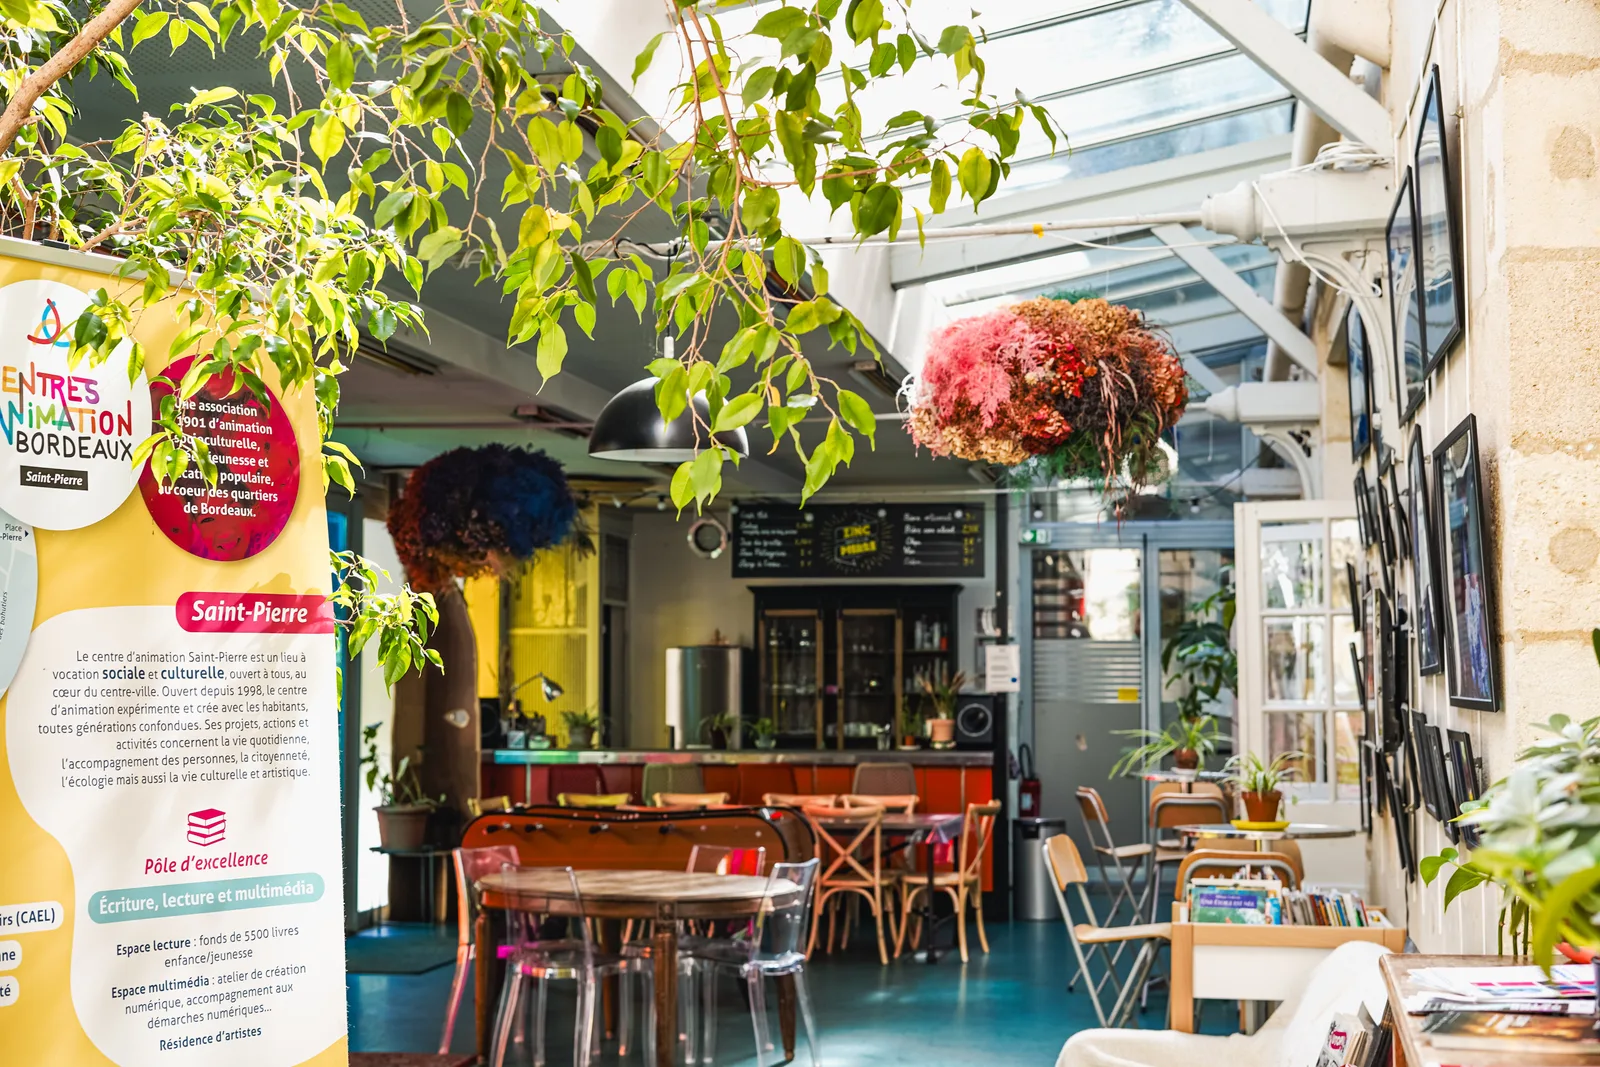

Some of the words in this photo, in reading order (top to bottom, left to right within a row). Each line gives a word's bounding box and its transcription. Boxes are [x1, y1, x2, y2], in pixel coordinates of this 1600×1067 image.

[198, 402, 257, 416] association
[176, 417, 206, 428] 1901
[209, 418, 272, 434] d'animation
[16, 430, 132, 461] BORDEAUX
[258, 458, 269, 467] et
[26, 471, 82, 486] Saint-Pierre
[220, 472, 274, 486] populaire,
[174, 487, 206, 496] coeur
[209, 487, 228, 498] des
[231, 489, 278, 502] quartiers
[184, 502, 198, 513] de
[201, 503, 256, 517] Bordeaux.
[5, 524, 22, 532] Place
[192, 600, 308, 623] Saint-Pierre
[77, 651, 89, 662] Le
[92, 652, 124, 662] centre
[126, 652, 185, 662] d'animation
[189, 652, 247, 663] Saint-Pierre
[250, 653, 265, 662] est
[280, 652, 298, 662] lieu
[301, 652, 306, 663] à
[52, 669, 99, 680] vocation
[102, 666, 145, 680] sociale
[148, 670, 158, 679] et
[161, 666, 227, 680] culturelle,
[229, 670, 261, 679] ouvert
[264, 668, 268, 679] à
[271, 670, 292, 680] tous,
[295, 670, 306, 679] au
[53, 688, 81, 698] cœur
[84, 686, 97, 697] du
[100, 686, 159, 697] centre-ville.
[162, 686, 198, 696] Ouvert
[201, 685, 234, 698] depuis
[238, 685, 264, 696] 1998,
[267, 685, 275, 695] le
[278, 685, 307, 695] centre
[50, 704, 114, 716] d'animation
[117, 703, 180, 717] expérimente
[184, 704, 193, 713] et
[196, 702, 219, 713] crée
[221, 704, 243, 712] avec
[246, 702, 260, 712] les
[262, 701, 308, 712] habitants,
[38, 724, 73, 734] toutes
[76, 721, 136, 736] générations
[139, 720, 202, 732] confondues.
[204, 719, 222, 730] Ses
[225, 719, 261, 732] projets,
[263, 718, 296, 728] actions
[298, 719, 309, 728] et
[116, 738, 157, 750] activités
[160, 738, 218, 749] concernent
[221, 736, 230, 746] la
[233, 736, 246, 746] vie
[250, 734, 309, 748] quotidienne,
[61, 757, 159, 771] l'accompagnement
[161, 755, 179, 766] des
[183, 754, 238, 768] personnes,
[240, 752, 249, 763] la
[251, 750, 310, 764] citoyenneté,
[61, 775, 114, 790] l'écologie
[116, 773, 138, 785] mais
[141, 772, 166, 784] aussi
[170, 772, 178, 782] la
[182, 771, 197, 782] vie
[200, 769, 247, 781] culturelle
[250, 770, 260, 779] et
[262, 767, 311, 779] artistique.
[144, 857, 177, 875] Pôle
[180, 852, 268, 872] d'excellence
[100, 896, 159, 915] Écriture,
[163, 891, 214, 908] lecture
[218, 890, 232, 903] et
[236, 880, 314, 901] multimédia
[16, 908, 55, 927] (CAEL)
[116, 942, 151, 957] Espace
[153, 937, 191, 951] lecture
[200, 933, 227, 946] fonds
[230, 930, 242, 942] de
[244, 928, 269, 942] 5500
[272, 925, 299, 938] livres
[164, 948, 253, 968] enfance/jeunesse
[111, 986, 146, 999] Espace
[148, 976, 210, 994] multimédia
[217, 970, 248, 985] atelier
[251, 968, 263, 979] de
[265, 964, 306, 978] création
[125, 998, 184, 1015] numérique,
[186, 986, 273, 1006] accompagnement
[276, 983, 294, 994] aux
[147, 1011, 204, 1029] démarches
[207, 1004, 272, 1021] numériques...
[159, 1035, 213, 1051] Résidence
[216, 1026, 262, 1042] d'artistes
